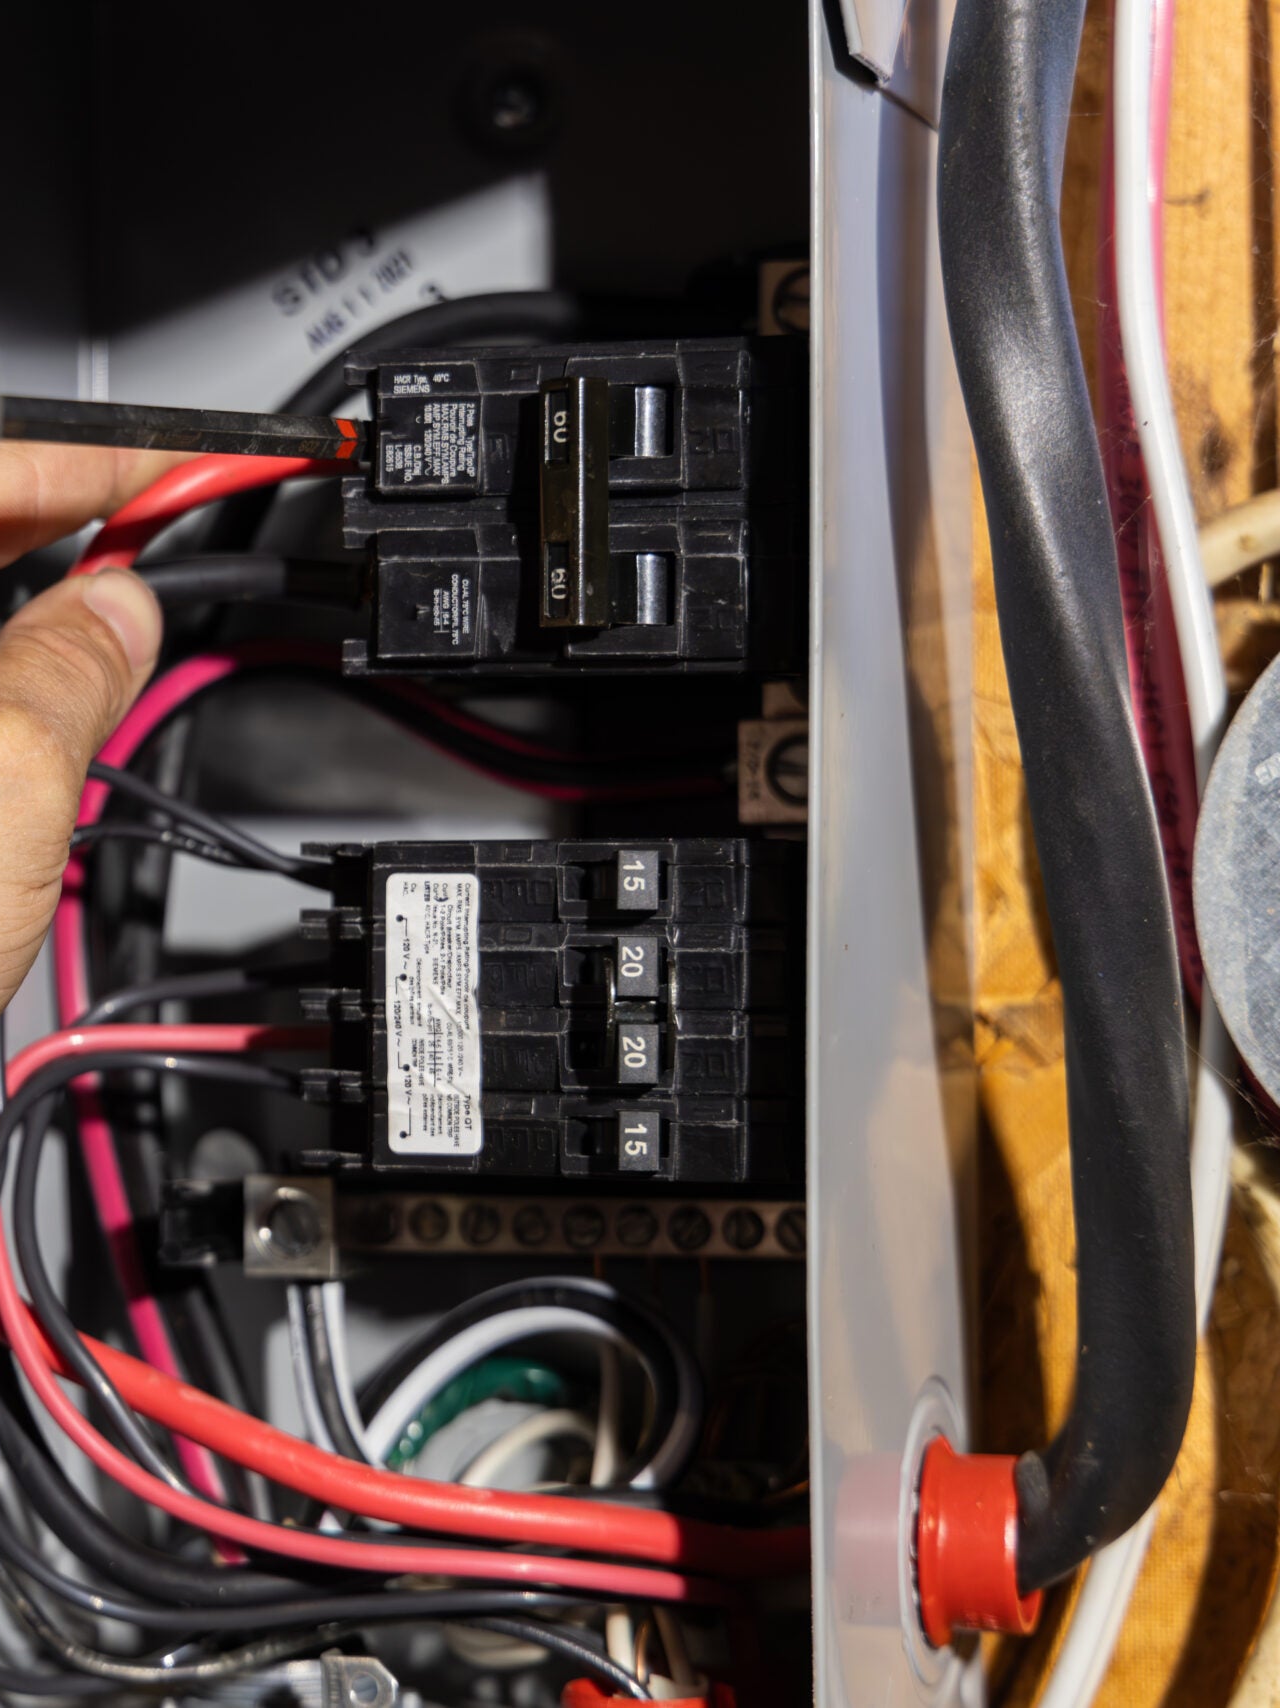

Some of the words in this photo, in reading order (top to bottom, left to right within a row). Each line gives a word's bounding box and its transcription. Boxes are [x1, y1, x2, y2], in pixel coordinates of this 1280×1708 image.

[394, 374, 411, 384] HACR
[394, 384, 430, 394] SIEMENS
[449, 404, 458, 432] Pouvoir
[457, 404, 466, 446] Interrupting
[424, 430, 432, 456] 120/240
[450, 433, 458, 444] de
[404, 445, 412, 468] ISSUE
[448, 445, 458, 478] Coupure
[457, 446, 466, 472] Rating
[550, 568, 568, 600] 60
[442, 590, 450, 610] AWG
[623, 860, 645, 892] 15
[620, 945, 644, 978] 20
[394, 1000, 402, 1029] 120/240
[622, 1036, 646, 1069] 20
[404, 1074, 412, 1088] 120
[464, 1118, 472, 1130] QT
[624, 1123, 648, 1156] 15
